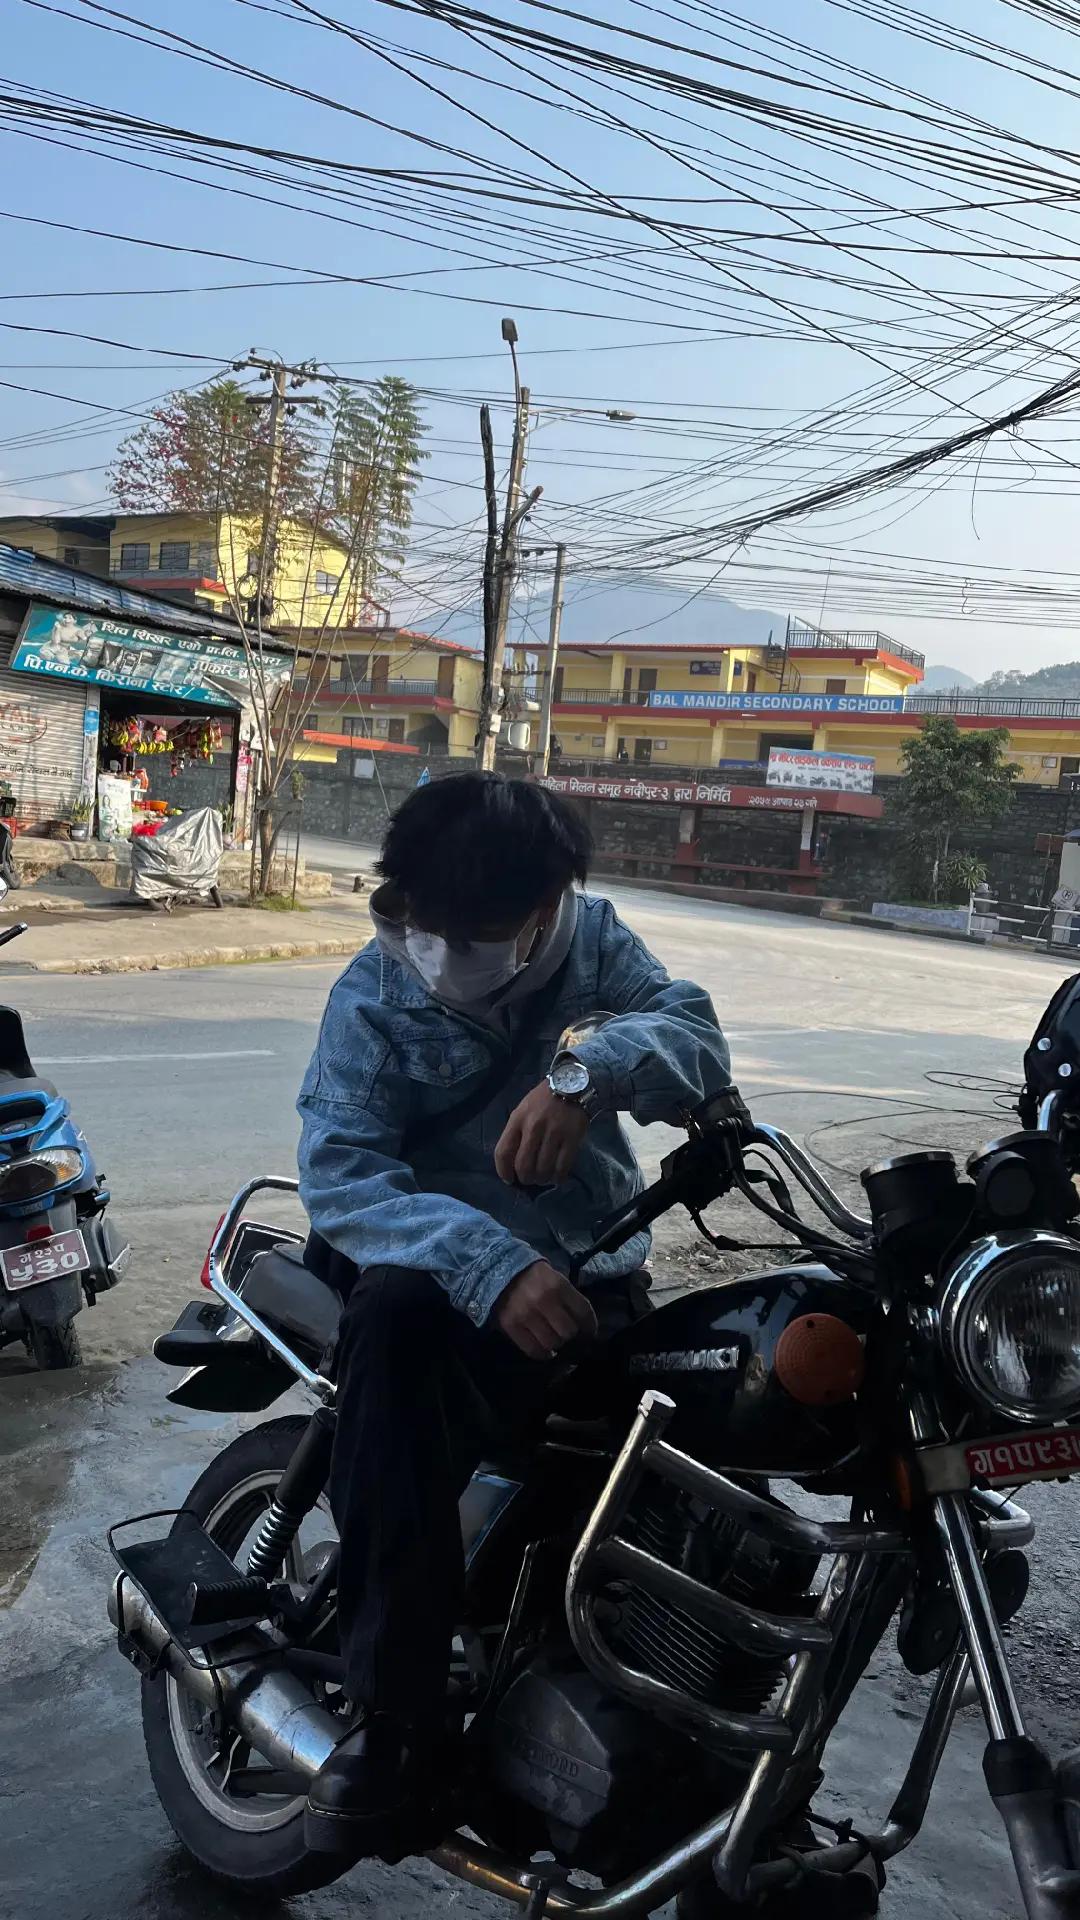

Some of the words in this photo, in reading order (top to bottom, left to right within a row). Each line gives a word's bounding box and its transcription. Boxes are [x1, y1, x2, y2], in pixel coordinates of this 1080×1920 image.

[101, 621, 128, 637] शिव
[95, 668, 149, 689] किराना
[653, 693, 678, 706] BAL
[683, 694, 740, 708] MANDIR
[743, 696, 833, 711] SECONDARY
[837, 698, 898, 713] SCHOOL
[570, 777, 596, 794] मिलन
[597, 783, 622, 798] समूह
[696, 785, 731, 803] निर्मित
[10, 1251, 80, 1281] ५३०
